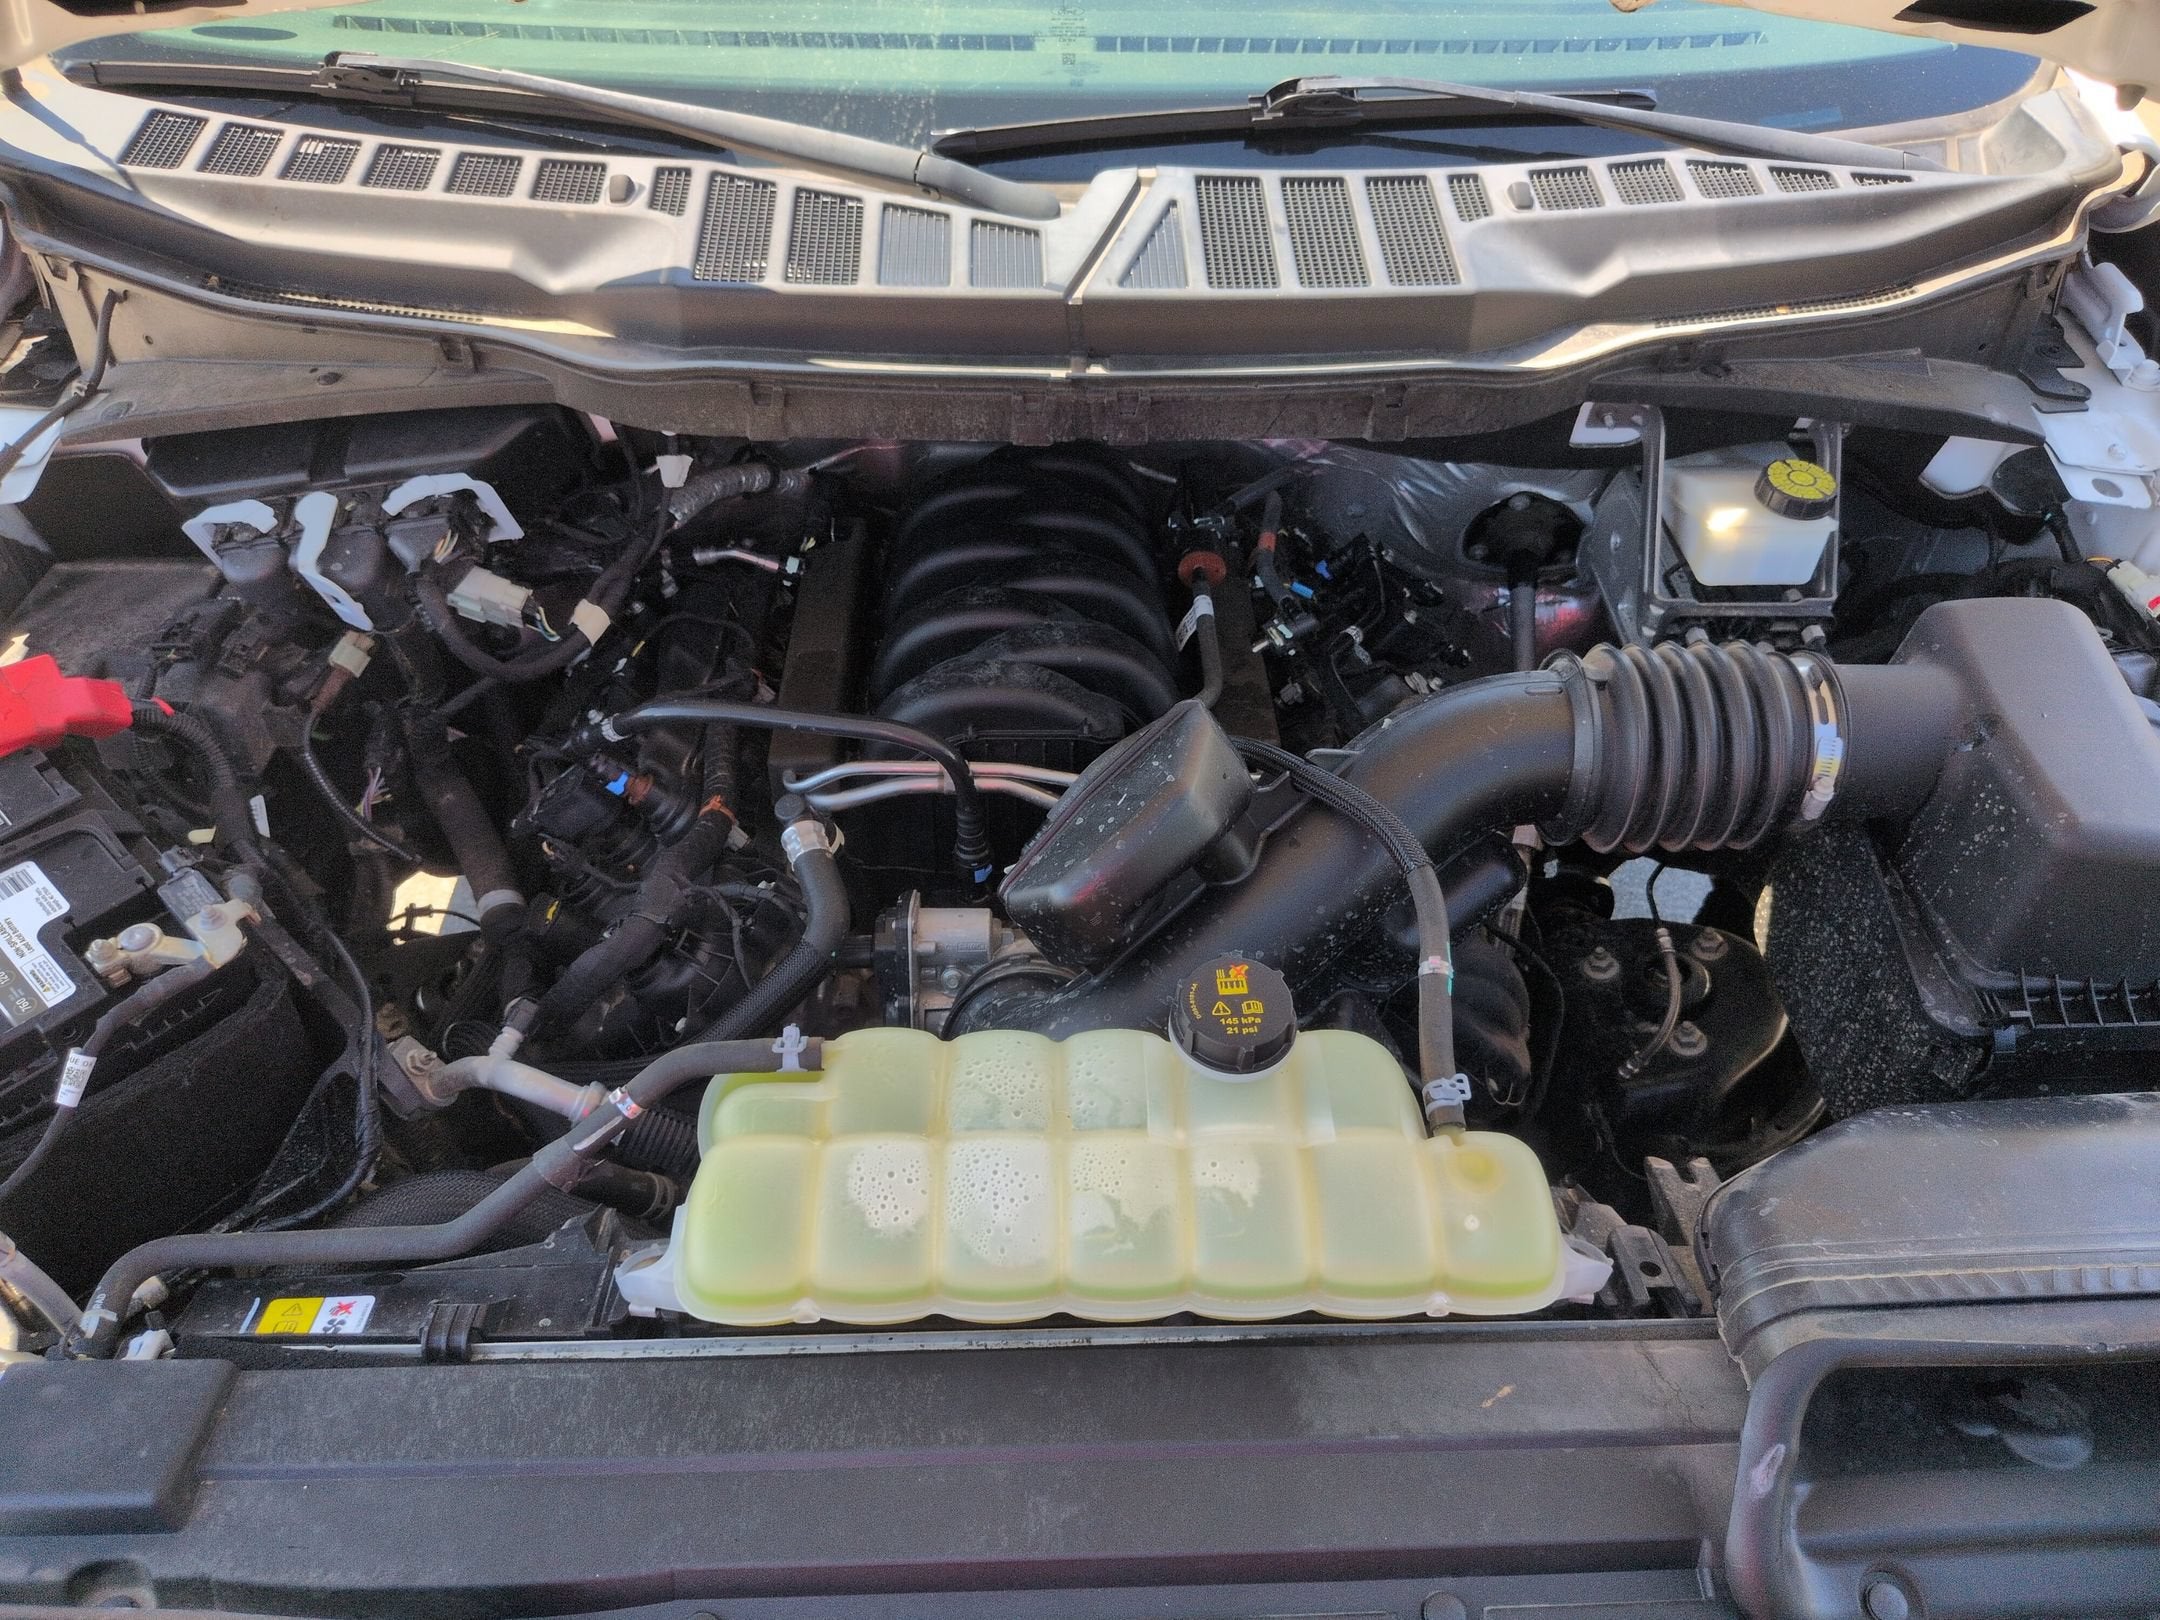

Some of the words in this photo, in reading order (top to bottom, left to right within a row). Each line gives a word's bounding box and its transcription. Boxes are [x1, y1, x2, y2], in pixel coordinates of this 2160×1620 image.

[16, 997, 32, 1013] 760
[1219, 1017, 1239, 1025] 145
[1241, 1016, 1262, 1024] kPa
[1226, 1026, 1239, 1035] 21
[1242, 1025, 1259, 1035] psi
